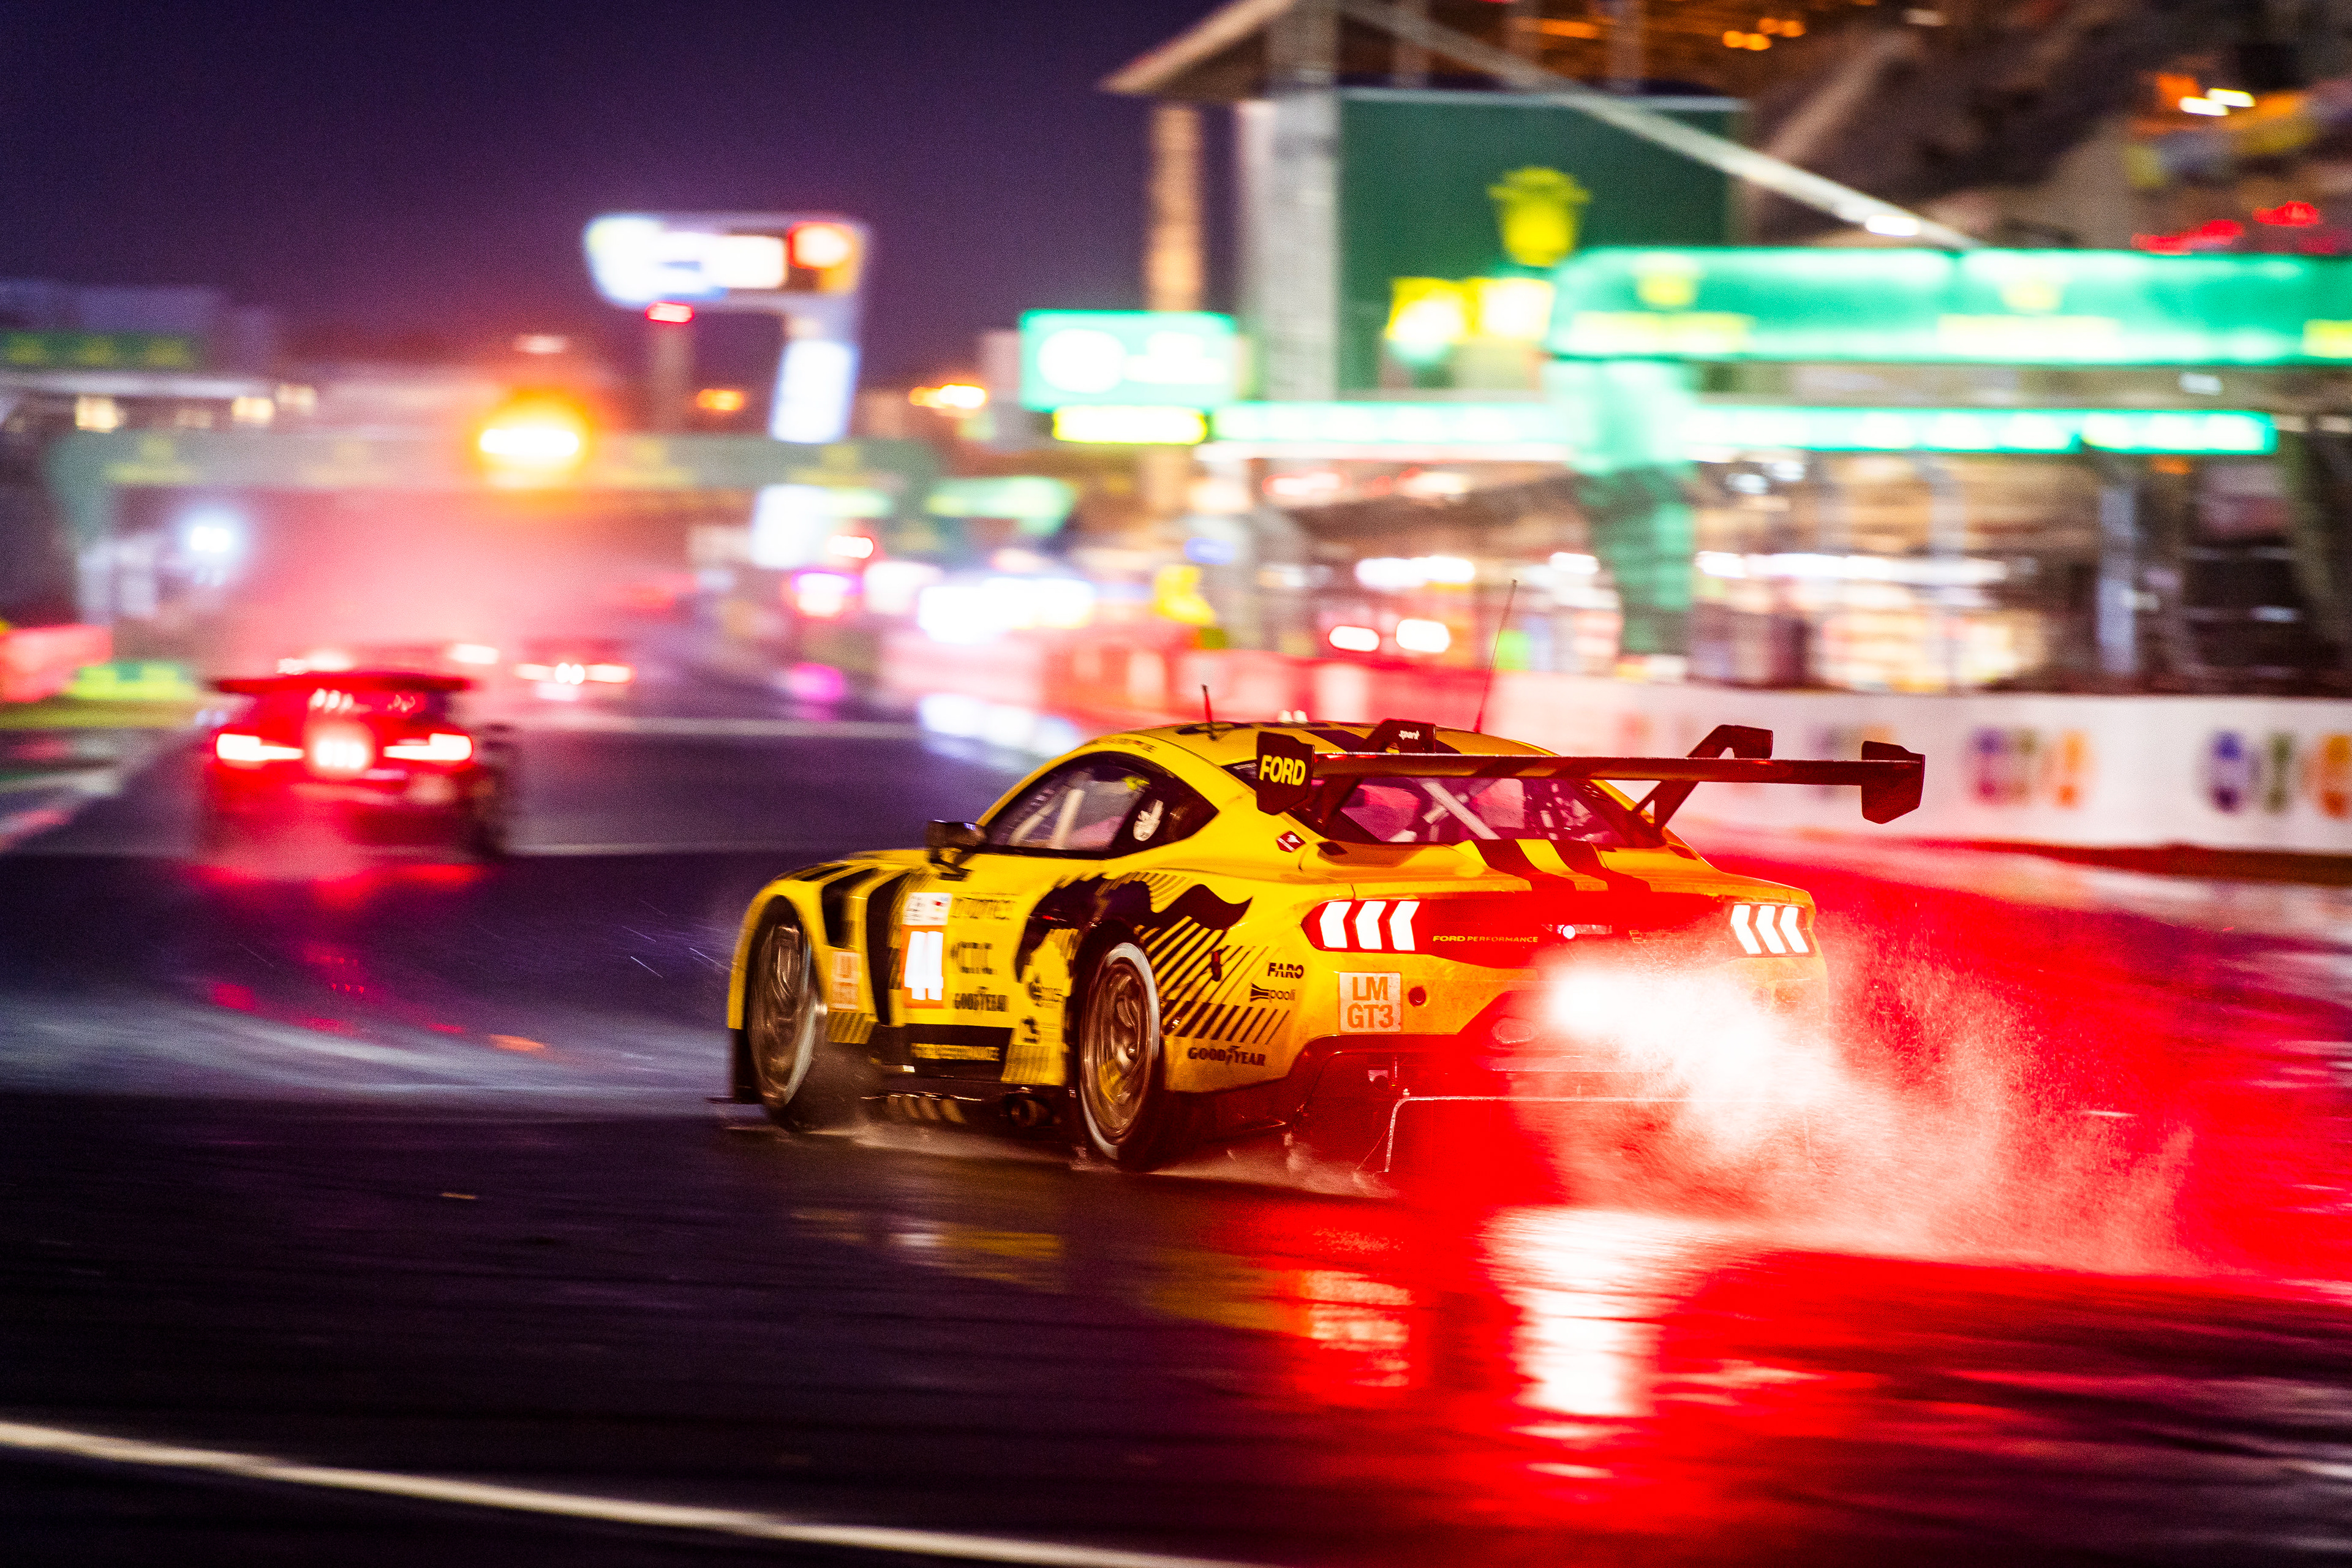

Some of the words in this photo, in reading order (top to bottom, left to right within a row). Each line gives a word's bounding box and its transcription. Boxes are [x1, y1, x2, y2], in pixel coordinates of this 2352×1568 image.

[1259, 755, 1306, 786] FORD
[1267, 962, 1304, 979] FARO
[1352, 976, 1389, 1001] LM
[1347, 1003, 1393, 1028] GT3
[1188, 1046, 1265, 1066] GOODYEAR
